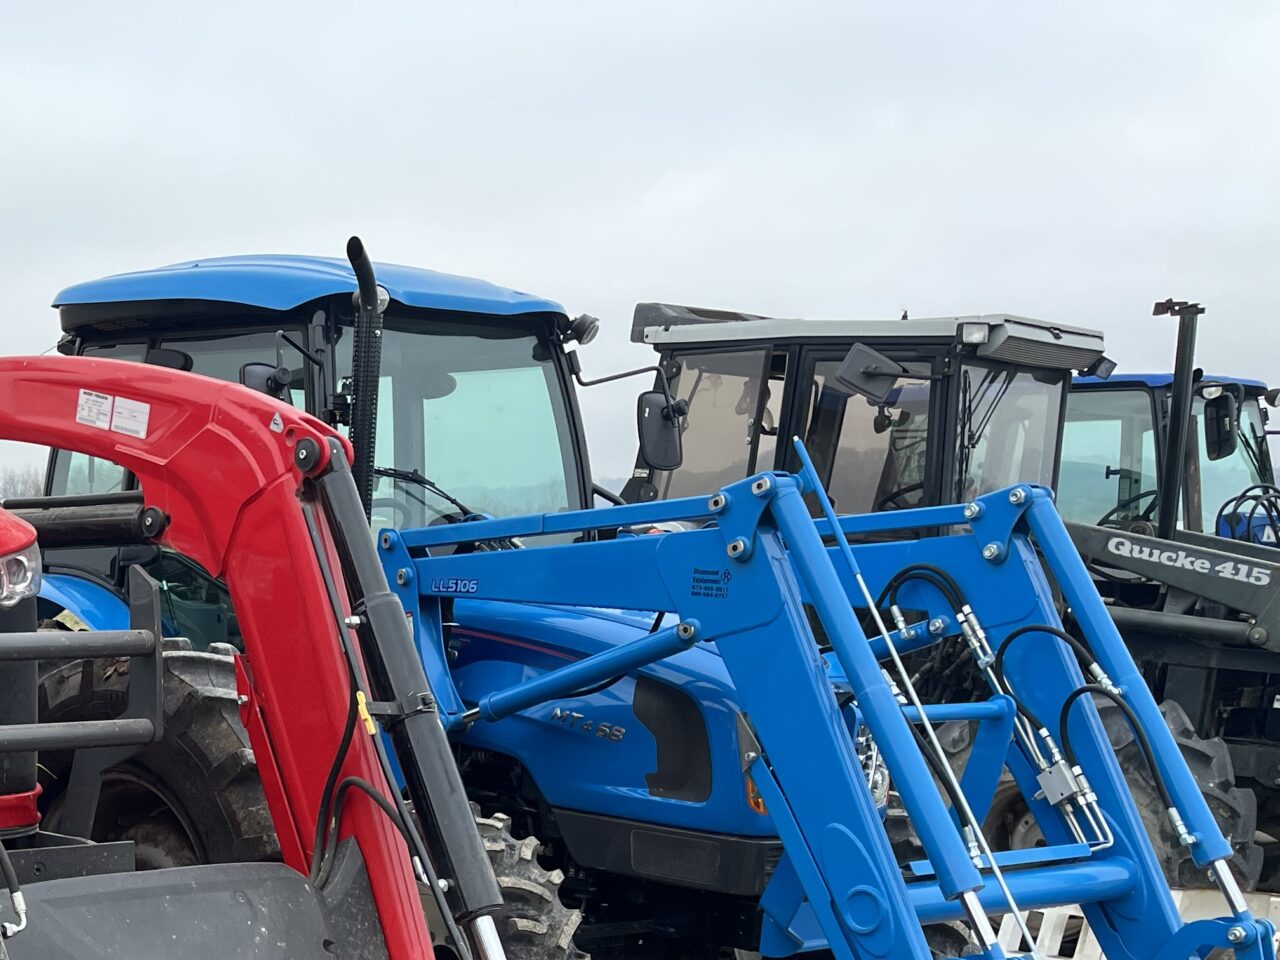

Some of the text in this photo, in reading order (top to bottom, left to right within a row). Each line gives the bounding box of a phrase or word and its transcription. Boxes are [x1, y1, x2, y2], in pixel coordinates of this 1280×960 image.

[1107, 537, 1272, 586] Quicke 415
[431, 579, 478, 592] LL5106
